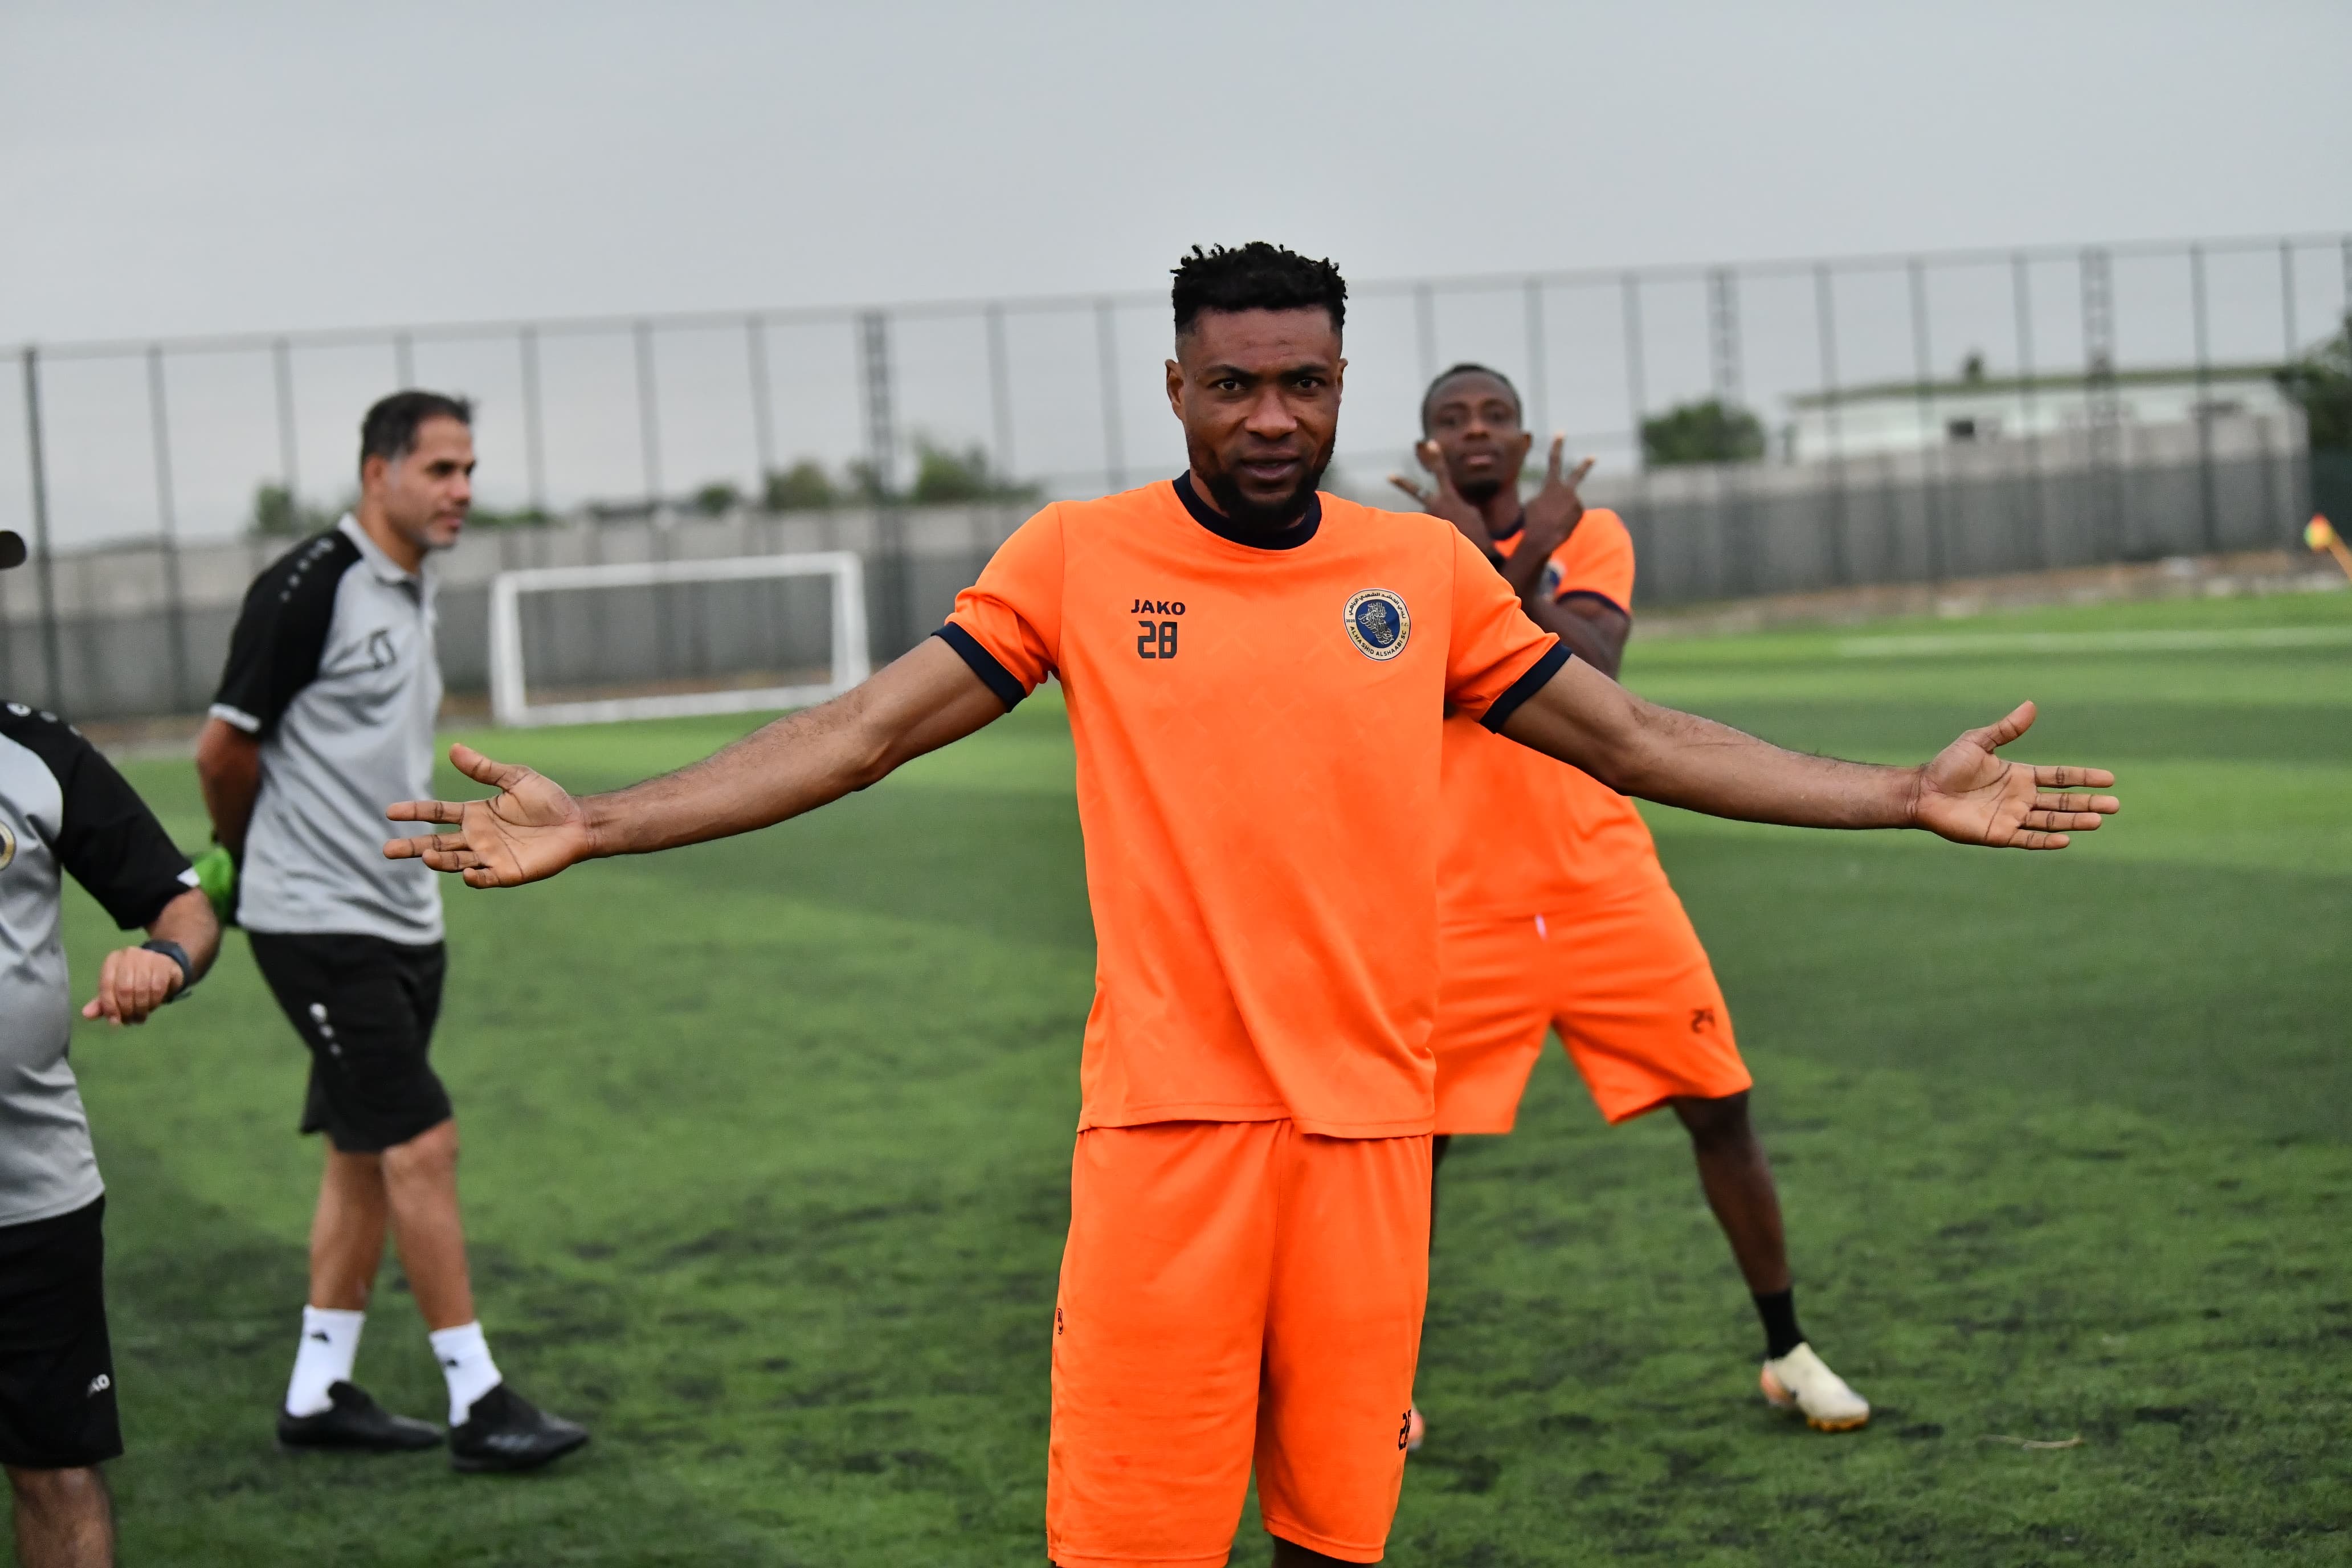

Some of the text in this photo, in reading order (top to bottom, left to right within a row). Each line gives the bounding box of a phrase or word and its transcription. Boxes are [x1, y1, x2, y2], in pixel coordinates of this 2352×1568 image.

[1359, 592, 1381, 601] الشعبي
[1381, 594, 1399, 605] الحشد
[1131, 599, 1186, 615] JAKO
[1398, 605, 1406, 619] نادي
[1138, 620, 1178, 659] 28
[1350, 626, 1406, 656] ALHASHID ALSHAABI SC
